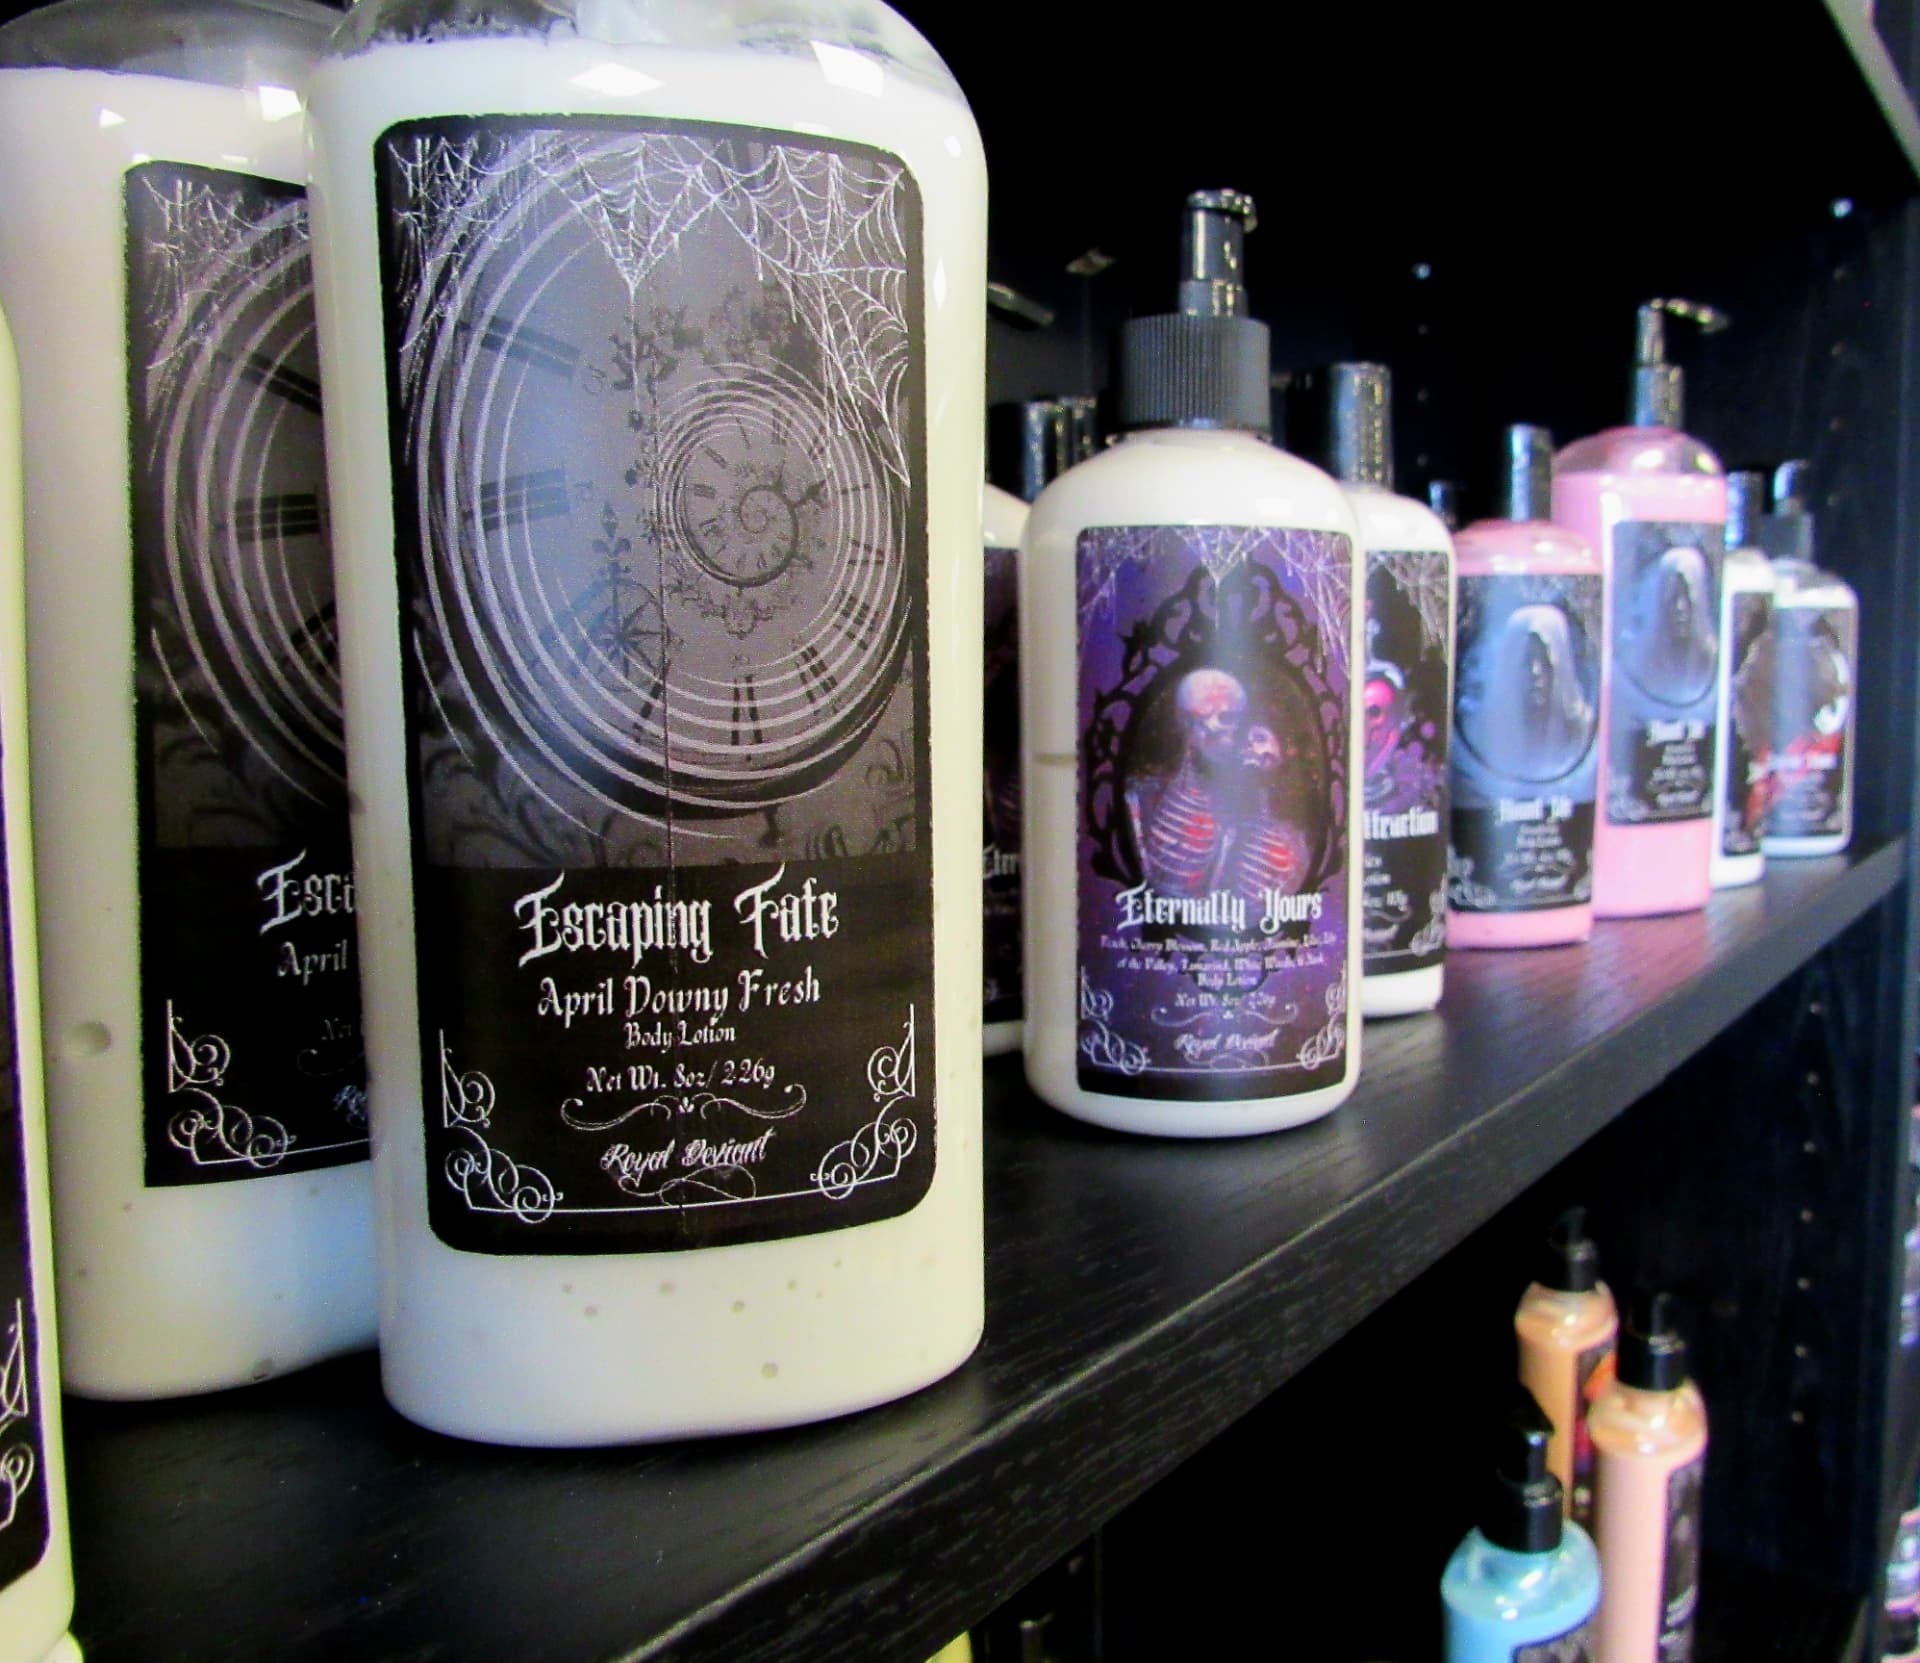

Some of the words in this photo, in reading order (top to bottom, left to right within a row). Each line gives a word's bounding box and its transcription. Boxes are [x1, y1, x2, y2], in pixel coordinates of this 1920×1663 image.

[514, 871, 713, 968] Escaping
[734, 863, 839, 959] Fate
[1116, 880, 1246, 931] Eternally
[1259, 888, 1322, 934] Yours
[277, 938, 348, 987] April
[538, 974, 614, 1029] April
[624, 971, 729, 1026] Downy
[738, 965, 821, 1014] Fresh
[624, 1021, 673, 1054] Body
[676, 1019, 736, 1046] Lotion
[600, 1137, 676, 1190] Royal
